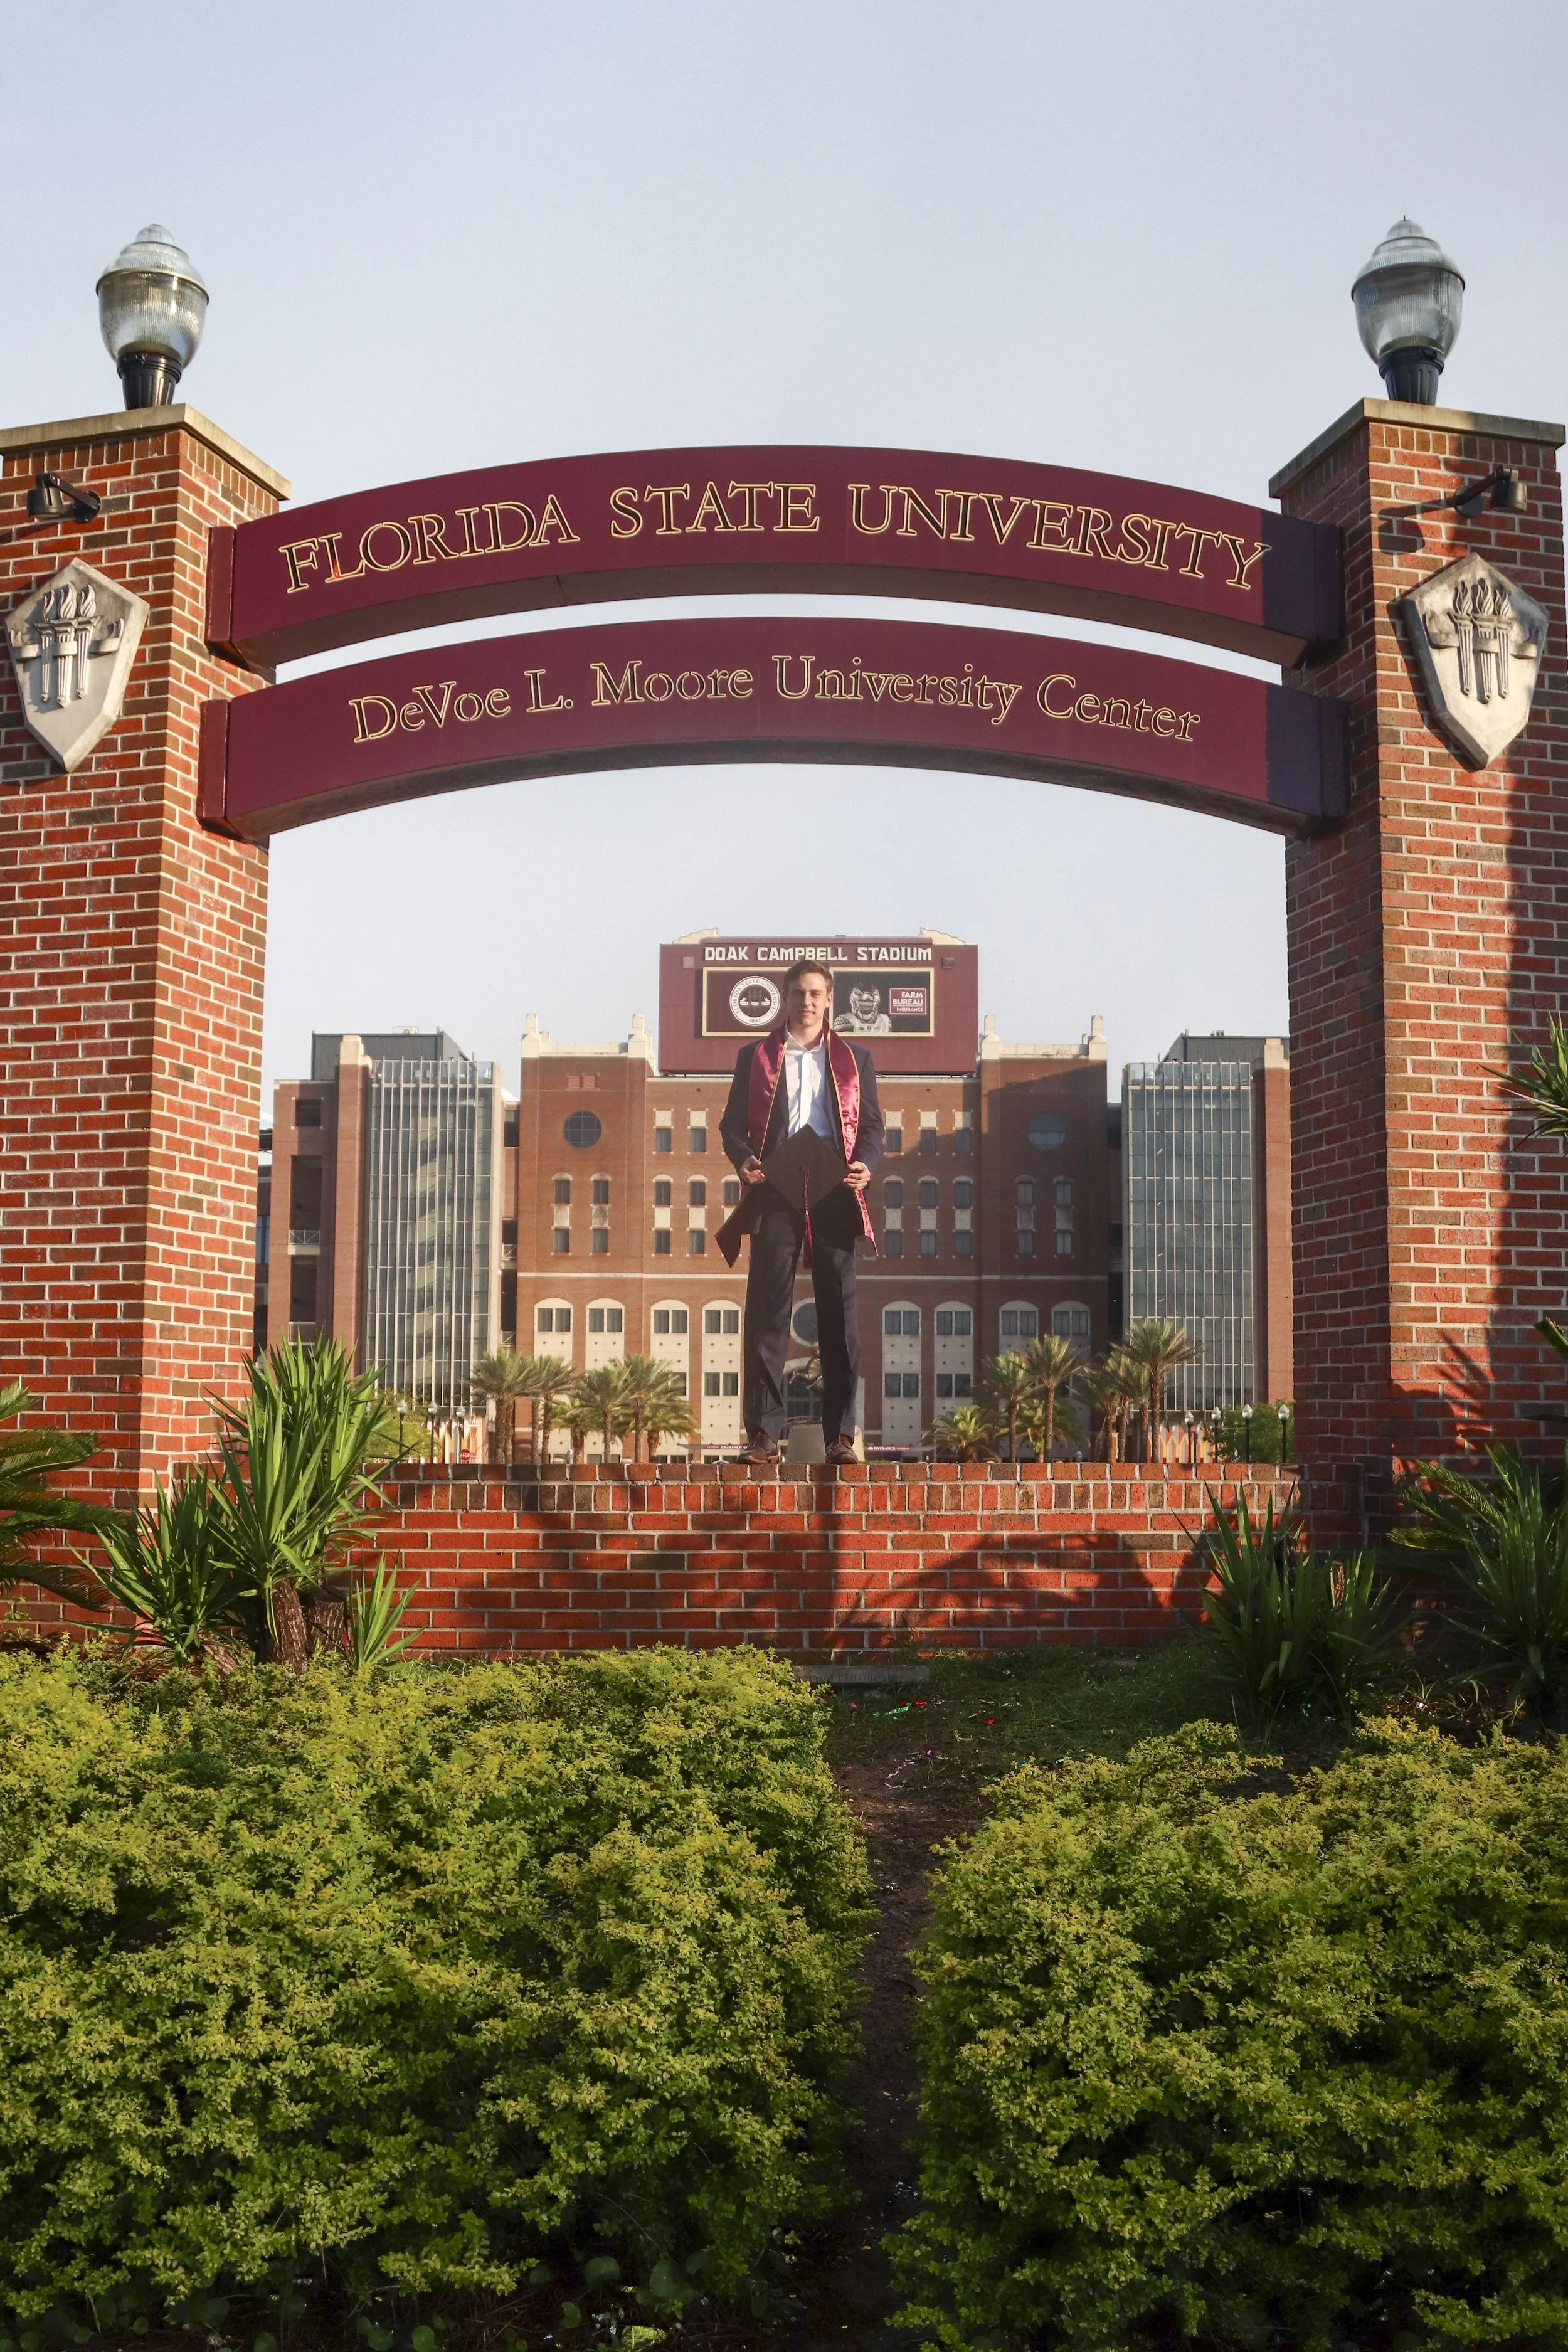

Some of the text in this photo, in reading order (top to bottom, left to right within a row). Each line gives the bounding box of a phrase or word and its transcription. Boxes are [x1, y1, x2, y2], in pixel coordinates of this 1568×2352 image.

[279, 480, 1272, 594] FLORIDA STATE UNIVERSITY
[348, 654, 1201, 743] DeVoe L. Moore University Center
[704, 946, 932, 961] DOAK CAMPBELL STADIUM
[733, 979, 777, 1014] FLORIDA STATE UNIVERSITY
